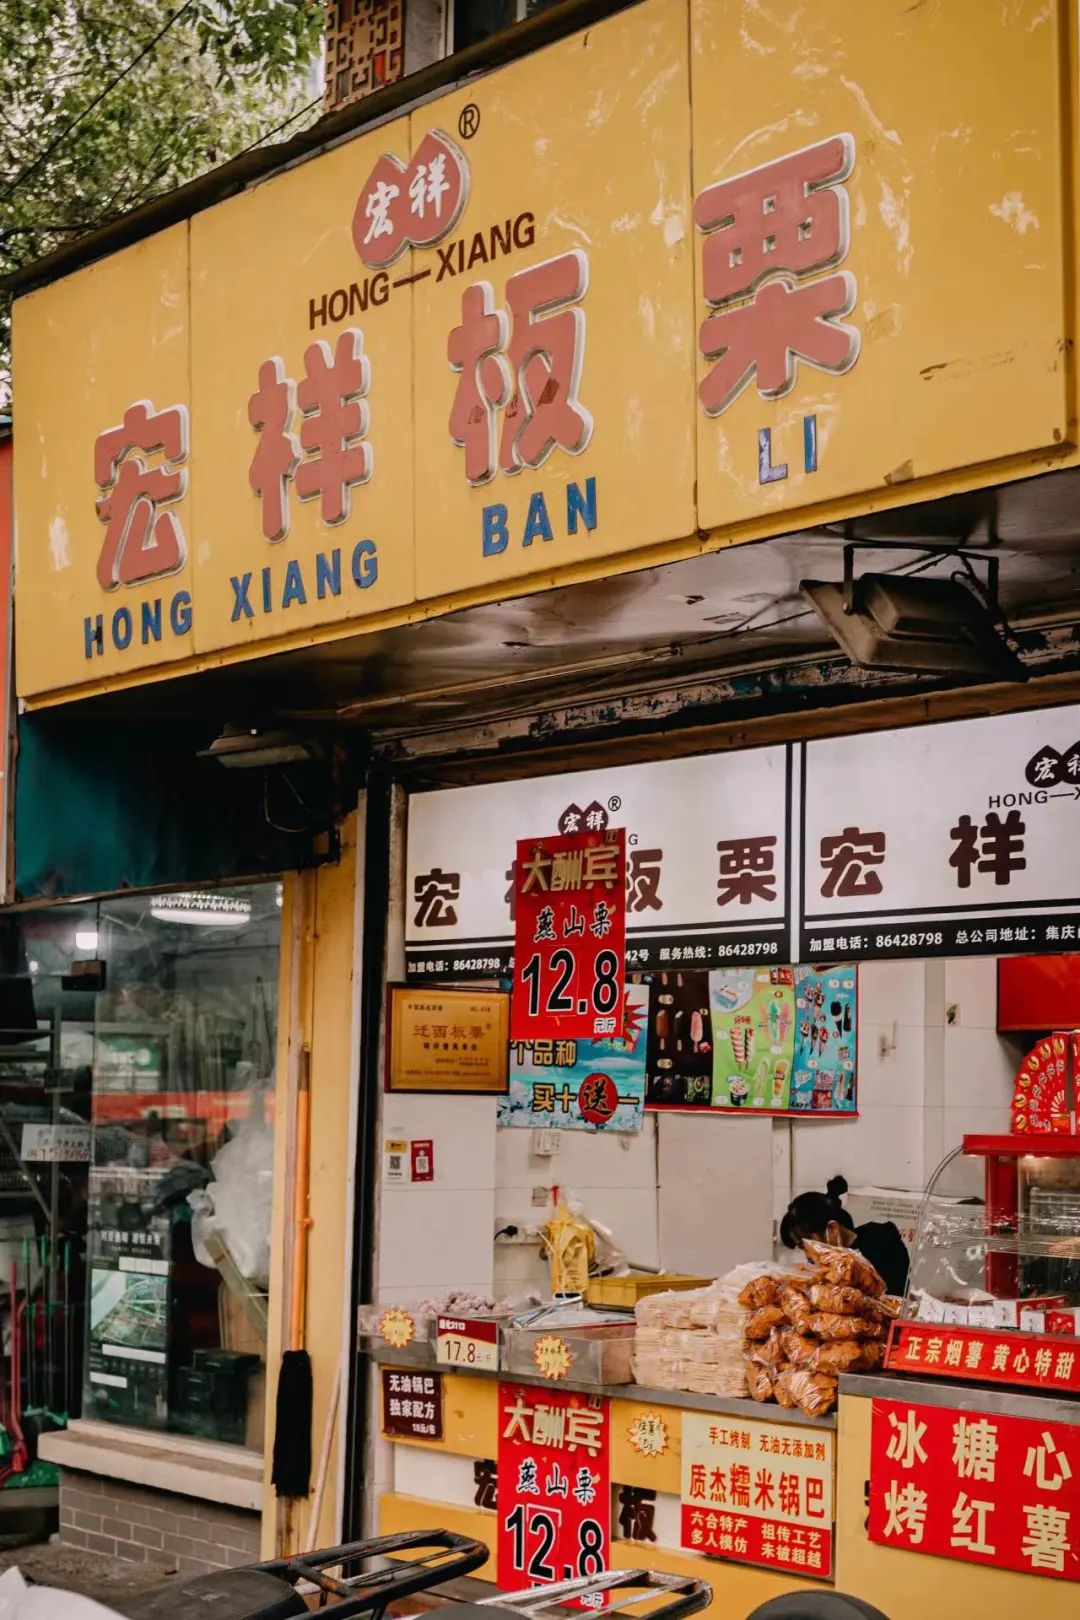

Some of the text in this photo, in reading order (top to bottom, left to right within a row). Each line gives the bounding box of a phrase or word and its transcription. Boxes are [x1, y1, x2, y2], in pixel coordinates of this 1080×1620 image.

[363, 152, 450, 245] 宏祥
[84, 414, 817, 658] HONG XIANG BAN LI
[521, 845, 620, 894] 大酬宾
[533, 902, 612, 942] 燕山栗
[522, 948, 619, 1017] 12.8
[445, 1340, 476, 1364] 17.8
[905, 1336, 1075, 1380] 正宗烟薯 黄心特甜
[389, 1375, 435, 1395] 无油锅巴
[389, 1398, 436, 1420] 独家配方
[503, 1398, 604, 1457] 大酬宾
[708, 1427, 826, 1461] 手工烤制 无油无添加剂
[886, 1410, 1073, 1491] 冰糖心
[516, 1456, 596, 1506] 燕山栗
[689, 1463, 826, 1519] 质杰糯米锅巴
[690, 1511, 822, 1549] 六合特产 祖传工艺
[690, 1529, 822, 1568] 多人模仿 未被超越
[883, 1480, 1071, 1572] 烤红薯
